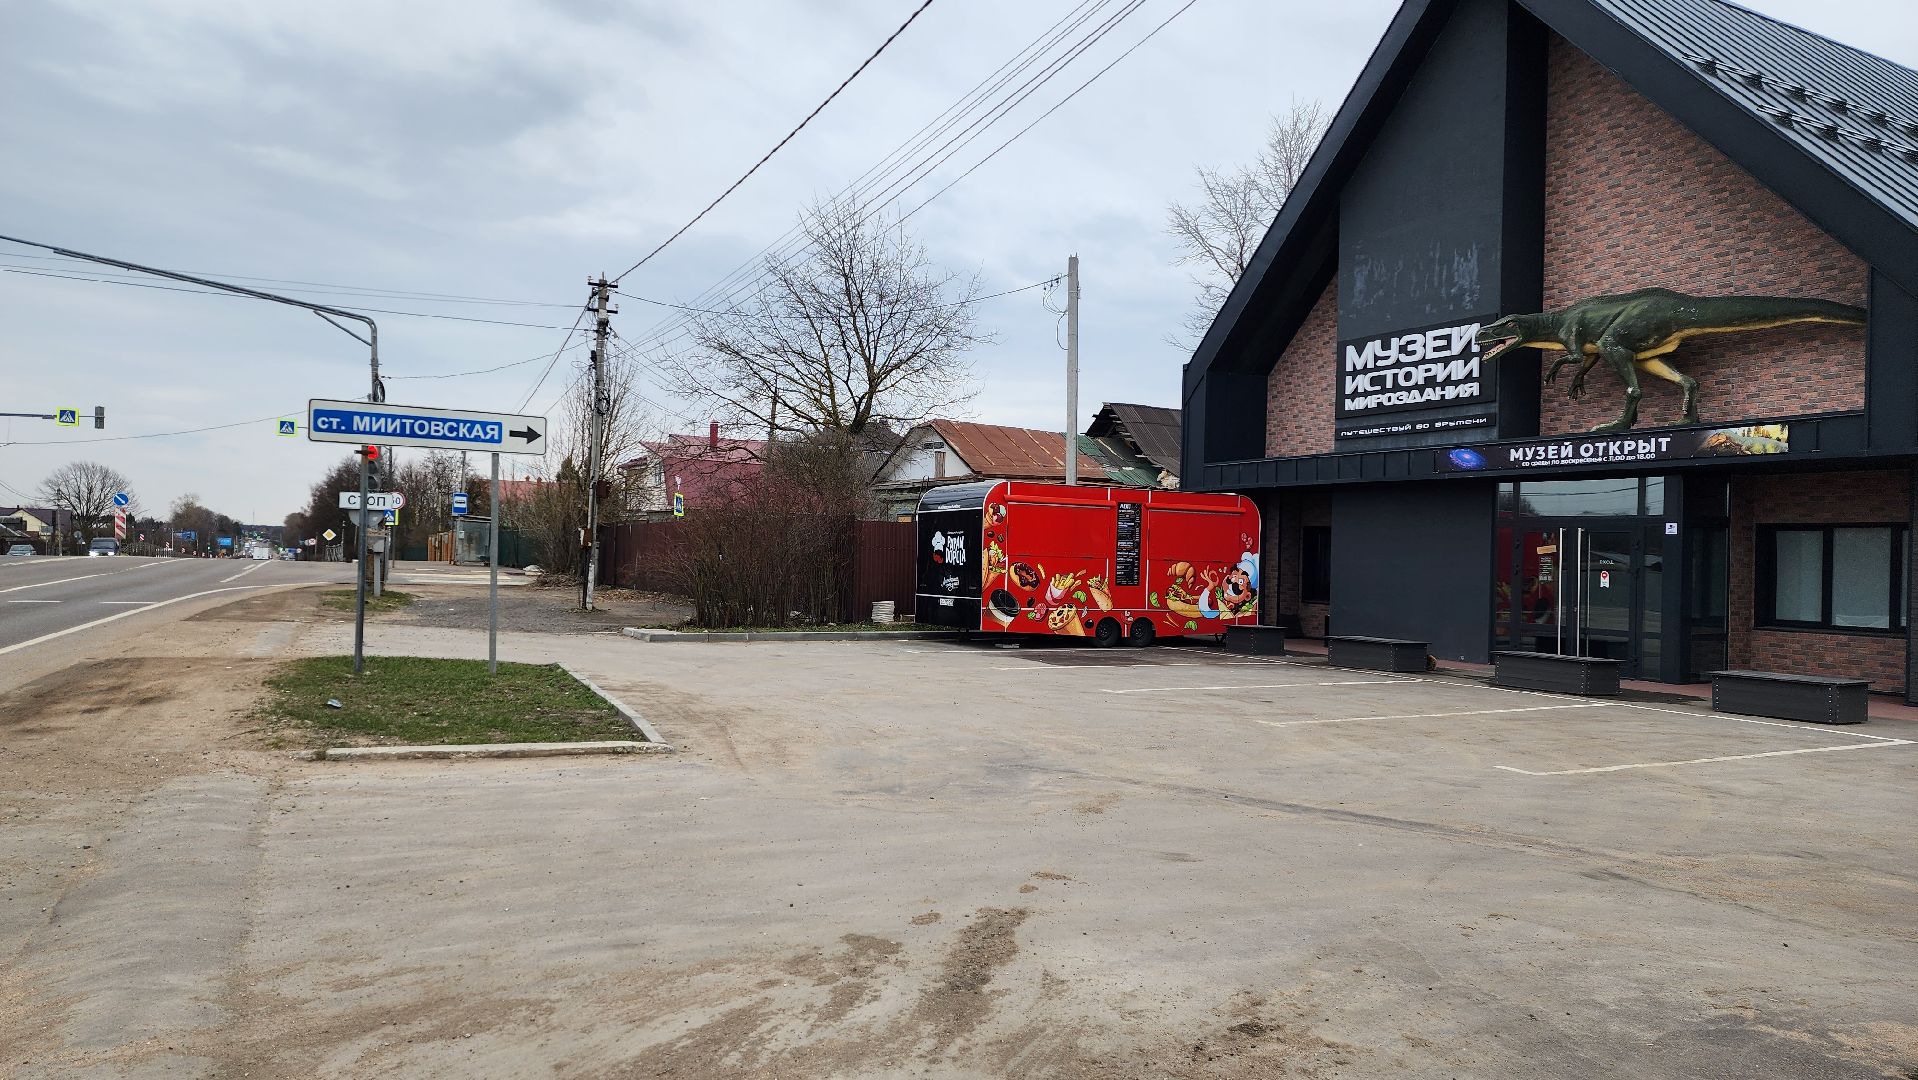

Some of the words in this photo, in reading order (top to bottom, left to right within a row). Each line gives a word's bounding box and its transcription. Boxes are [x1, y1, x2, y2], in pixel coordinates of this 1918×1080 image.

[1345, 356, 1480, 395] ИСТОРИИ
[1344, 381, 1480, 411] МИРОЗДАНИЯ
[316, 416, 346, 430] ст.
[352, 415, 499, 440] МИИТОВСКАЯ
[1509, 441, 1573, 461] МУЗЕЙ
[1579, 437, 1671, 457] ОТКРЫТ
[347, 495, 386, 507] СОП
